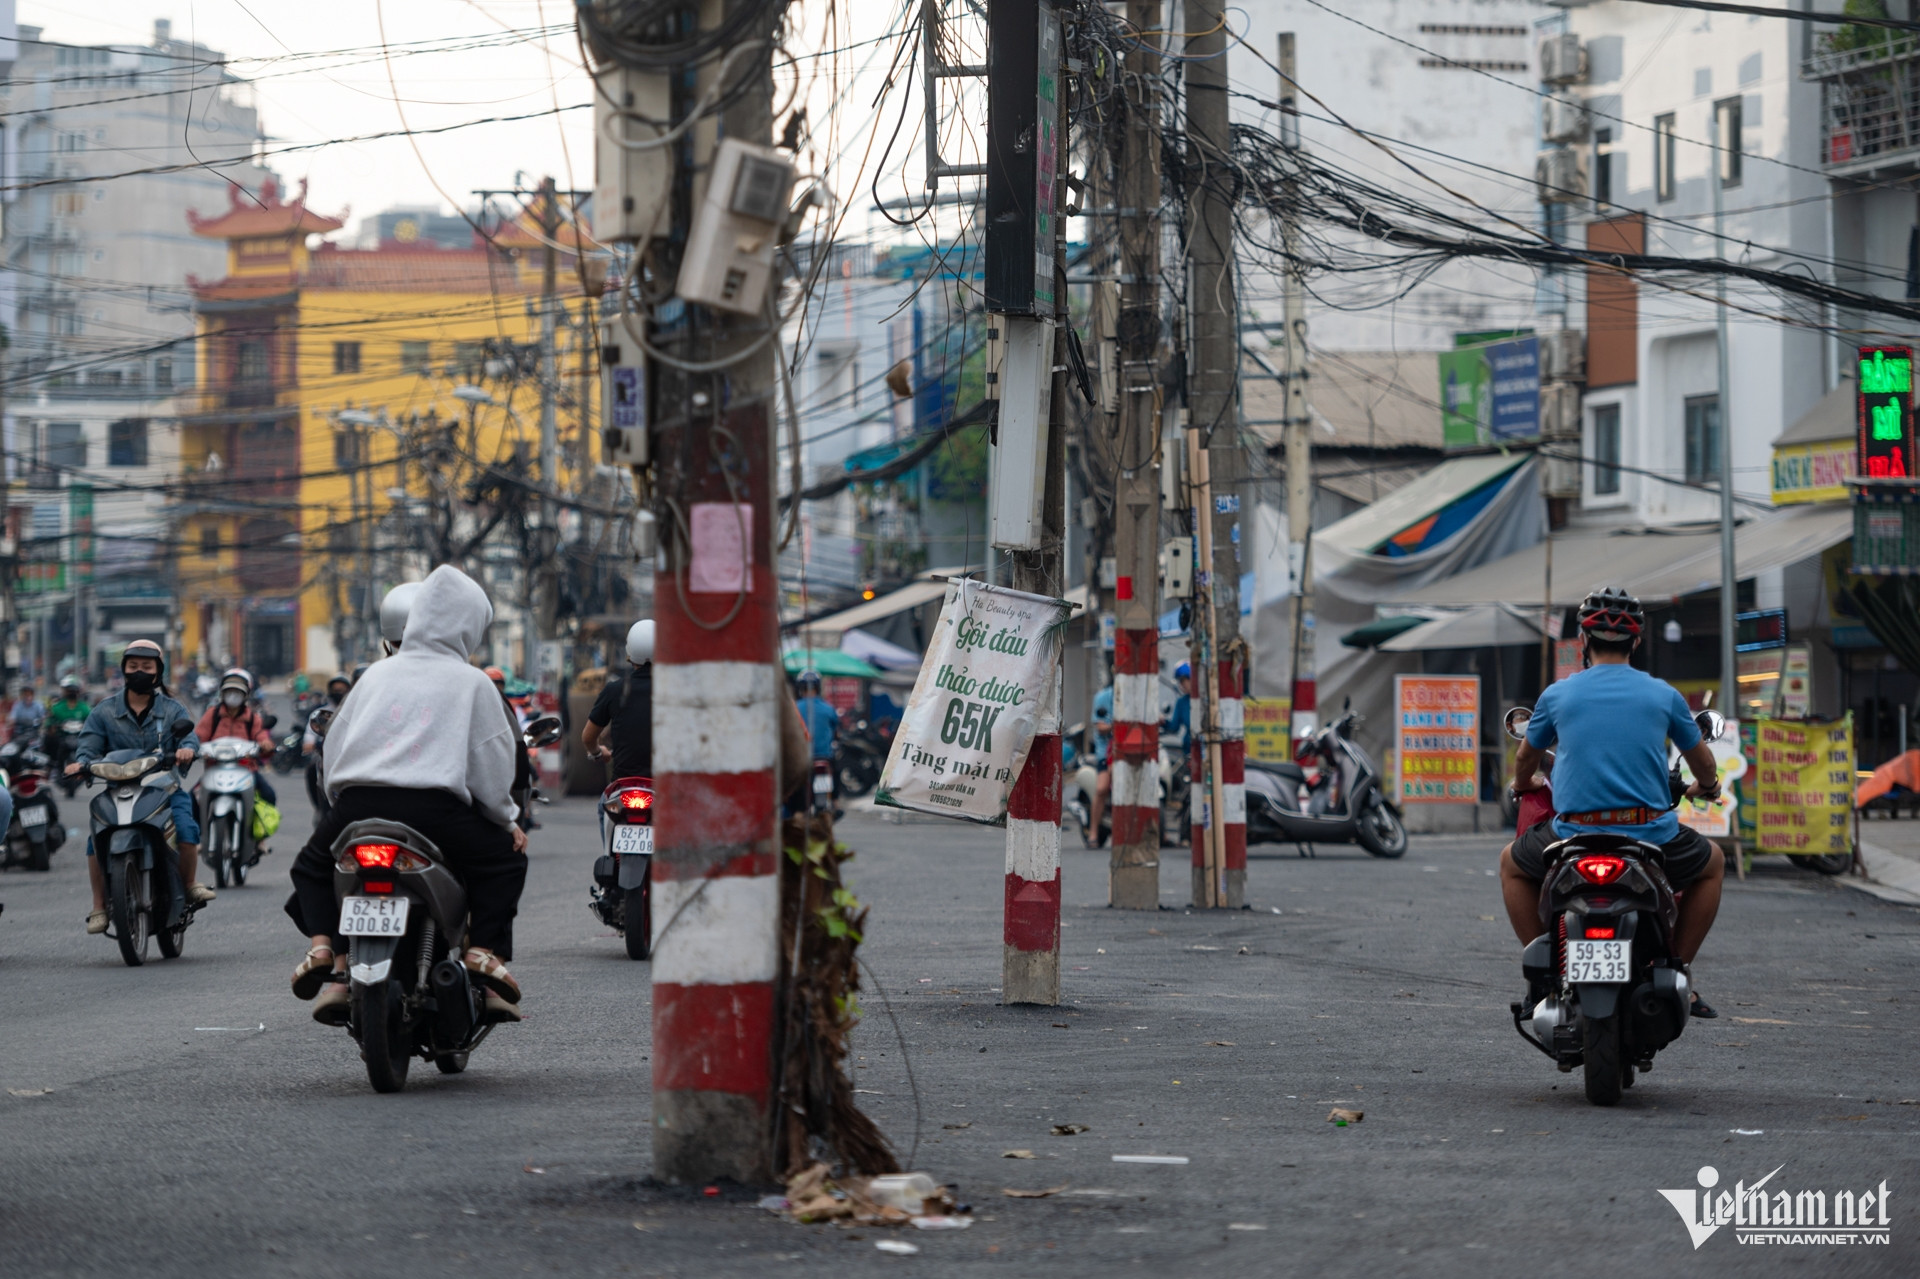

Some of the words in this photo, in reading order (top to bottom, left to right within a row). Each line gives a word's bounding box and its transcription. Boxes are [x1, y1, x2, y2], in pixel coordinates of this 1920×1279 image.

[986, 602, 1015, 620] Beauty
[1017, 608, 1032, 620] spa
[955, 614, 988, 653] Gội
[989, 624, 1029, 656] đầu
[935, 664, 978, 695] thảo
[978, 676, 1025, 711] dược
[940, 697, 1000, 753] 65K
[1762, 727, 1784, 742] RAU
[1828, 730, 1847, 743] 10K
[902, 742, 948, 775] Tặng
[952, 759, 991, 781] mặt
[1828, 751, 1848, 763] 10K
[1762, 769, 1778, 784] CÀ
[1829, 772, 1849, 785] 15K
[1830, 792, 1848, 806] 20K
[1762, 813, 1789, 827] SINH
[621, 827, 650, 839] 62-P1
[616, 840, 653, 851] 437.08
[353, 900, 396, 915] 62-E1
[345, 917, 401, 933] 300.84
[1576, 943, 1622, 960] 59-S3
[1571, 962, 1626, 980] 575.35
